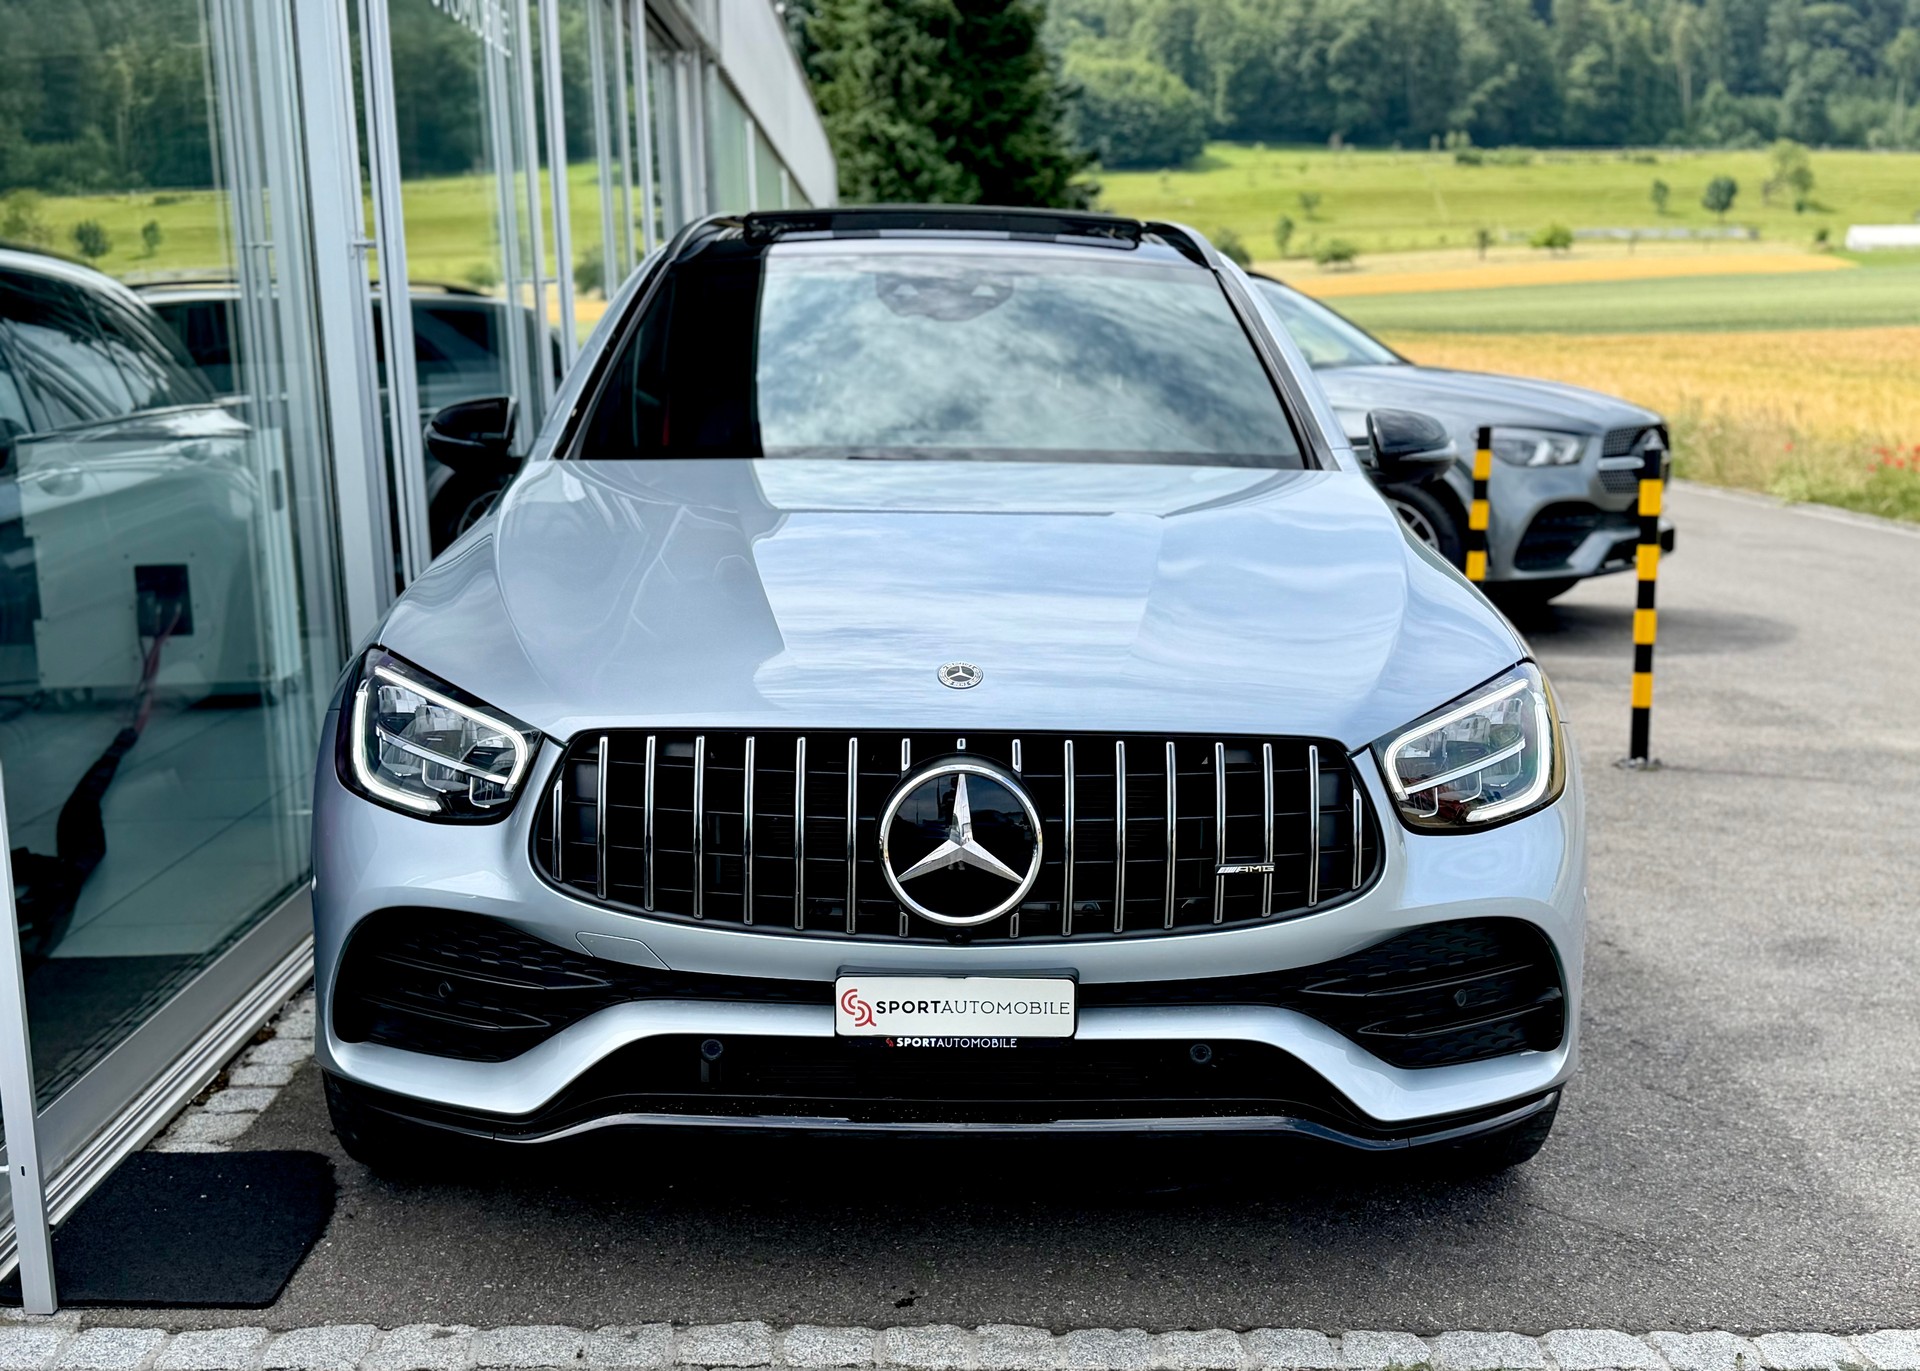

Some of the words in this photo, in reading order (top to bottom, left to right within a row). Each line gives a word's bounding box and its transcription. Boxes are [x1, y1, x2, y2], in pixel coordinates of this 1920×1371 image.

[1235, 865, 1275, 873] AMG
[876, 1000, 1070, 1015] SPORTAUTOMOBILE
[896, 1037, 1018, 1048] SPORTAUTOMOBILE
